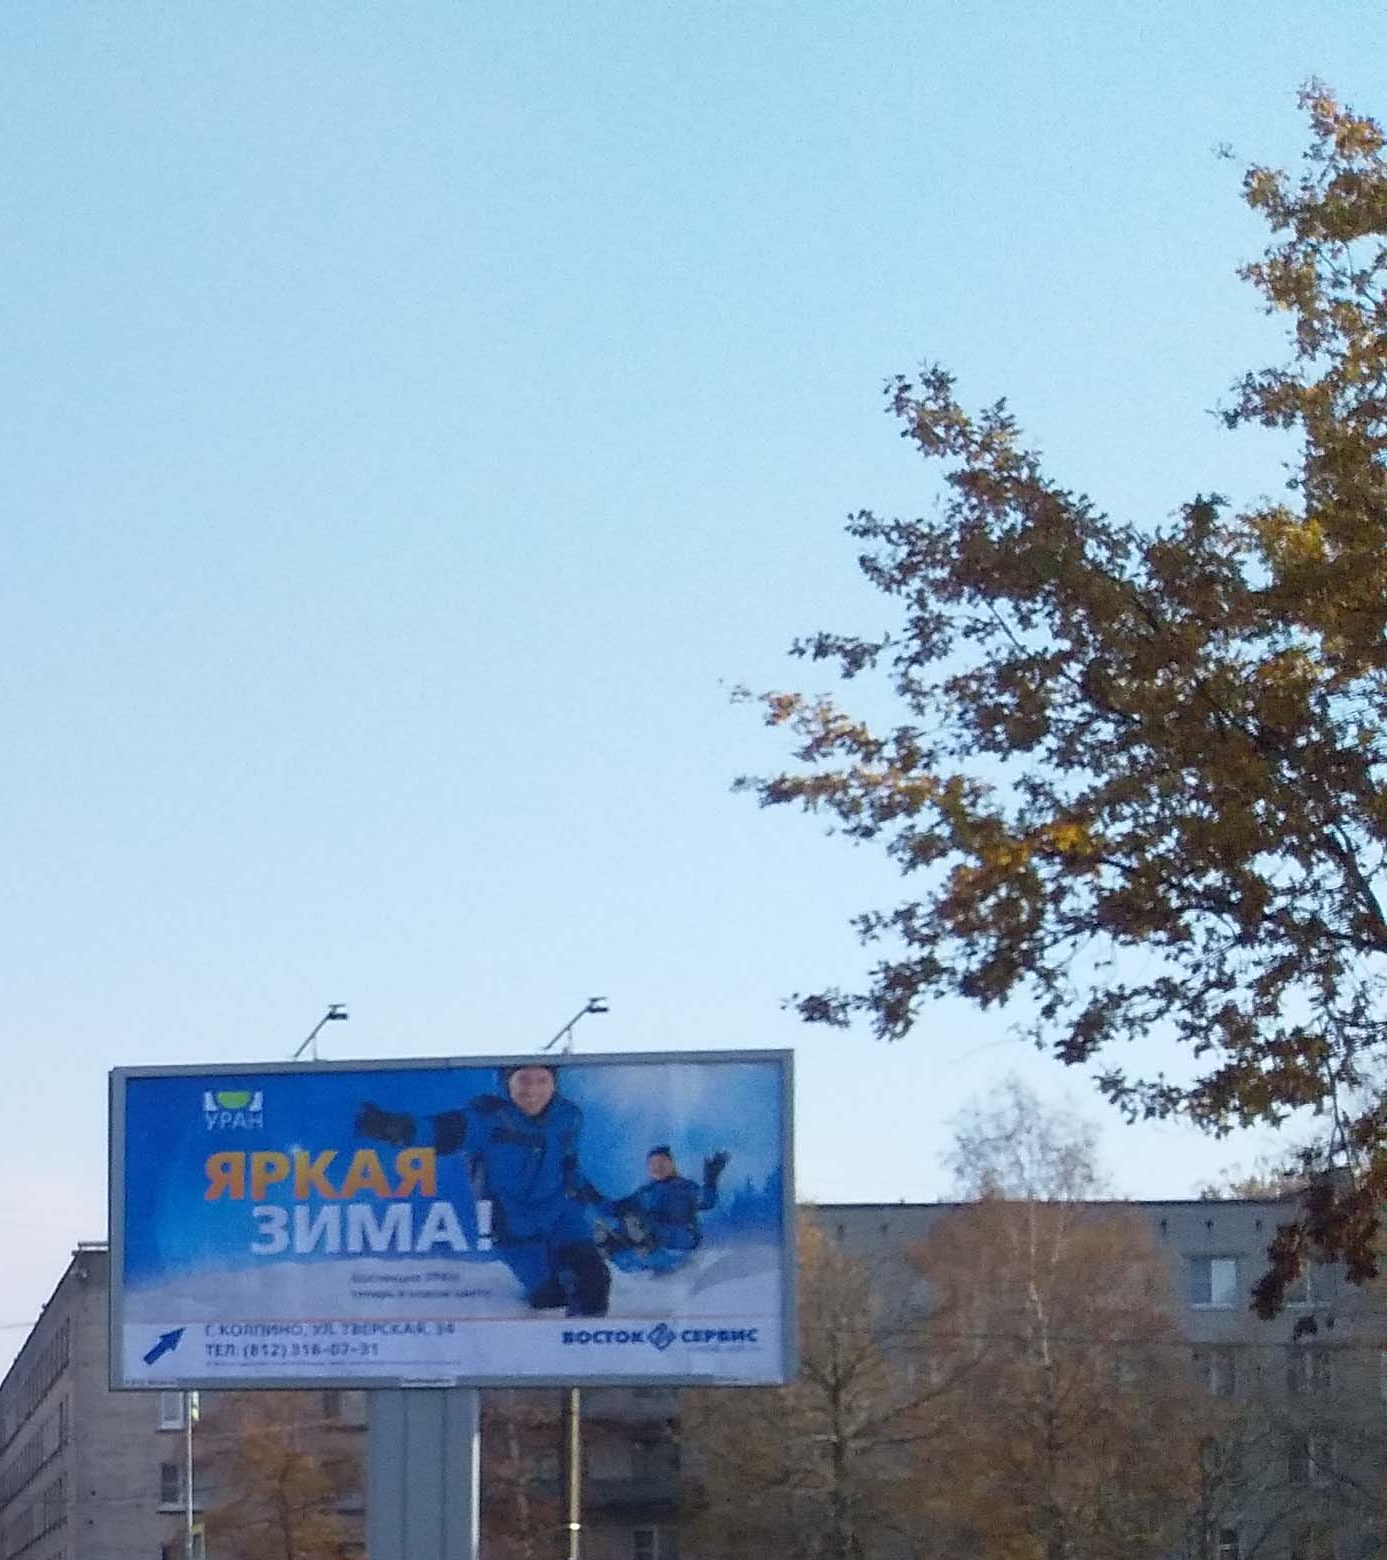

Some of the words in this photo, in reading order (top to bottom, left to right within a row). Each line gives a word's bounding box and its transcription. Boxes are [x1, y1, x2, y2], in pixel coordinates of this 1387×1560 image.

[205, 1110, 263, 1131] УРАН
[205, 1147, 436, 1201] ЯРКАЯ
[251, 1199, 493, 1255] ЗИМА!
[562, 1330, 646, 1344] ВОСТОК
[681, 1328, 759, 1343] СЕРВИС
[243, 1343, 287, 1359] (812)
